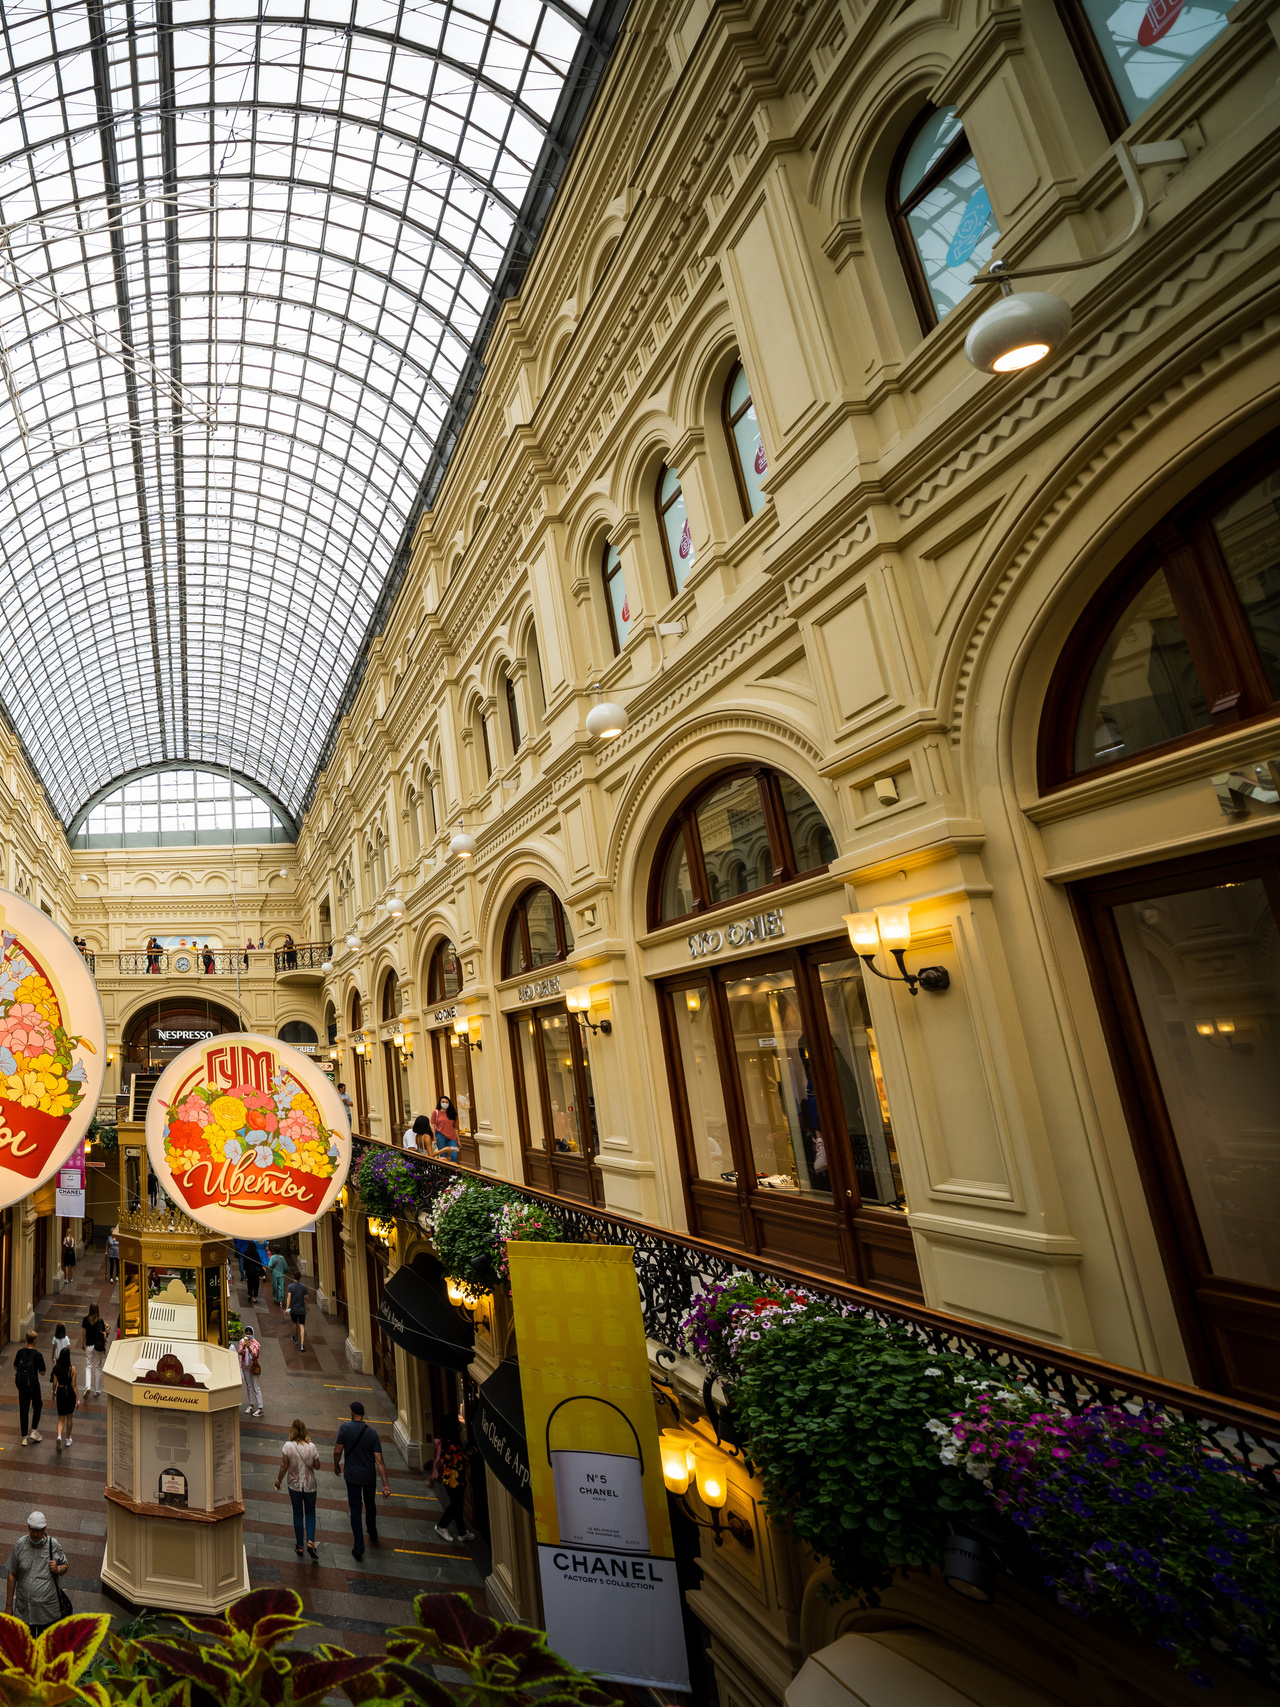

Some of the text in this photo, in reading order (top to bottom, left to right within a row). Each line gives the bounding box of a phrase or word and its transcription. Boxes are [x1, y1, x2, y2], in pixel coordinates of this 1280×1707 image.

[687, 909, 785, 957] NO ONE
[156, 1029, 213, 1041] NESPRESSO
[206, 1046, 275, 1094] ГУМ
[183, 1149, 313, 1207] Цветы
[143, 1390, 199, 1404] Современник
[489, 1422, 507, 1455] Cleef
[505, 1447, 511, 1465] &
[579, 1487, 618, 1497] CHANEL
[553, 1552, 663, 1582] CHANEL
[564, 1574, 597, 1583] FACTORY
[605, 1579, 655, 1590] COLLECTION
